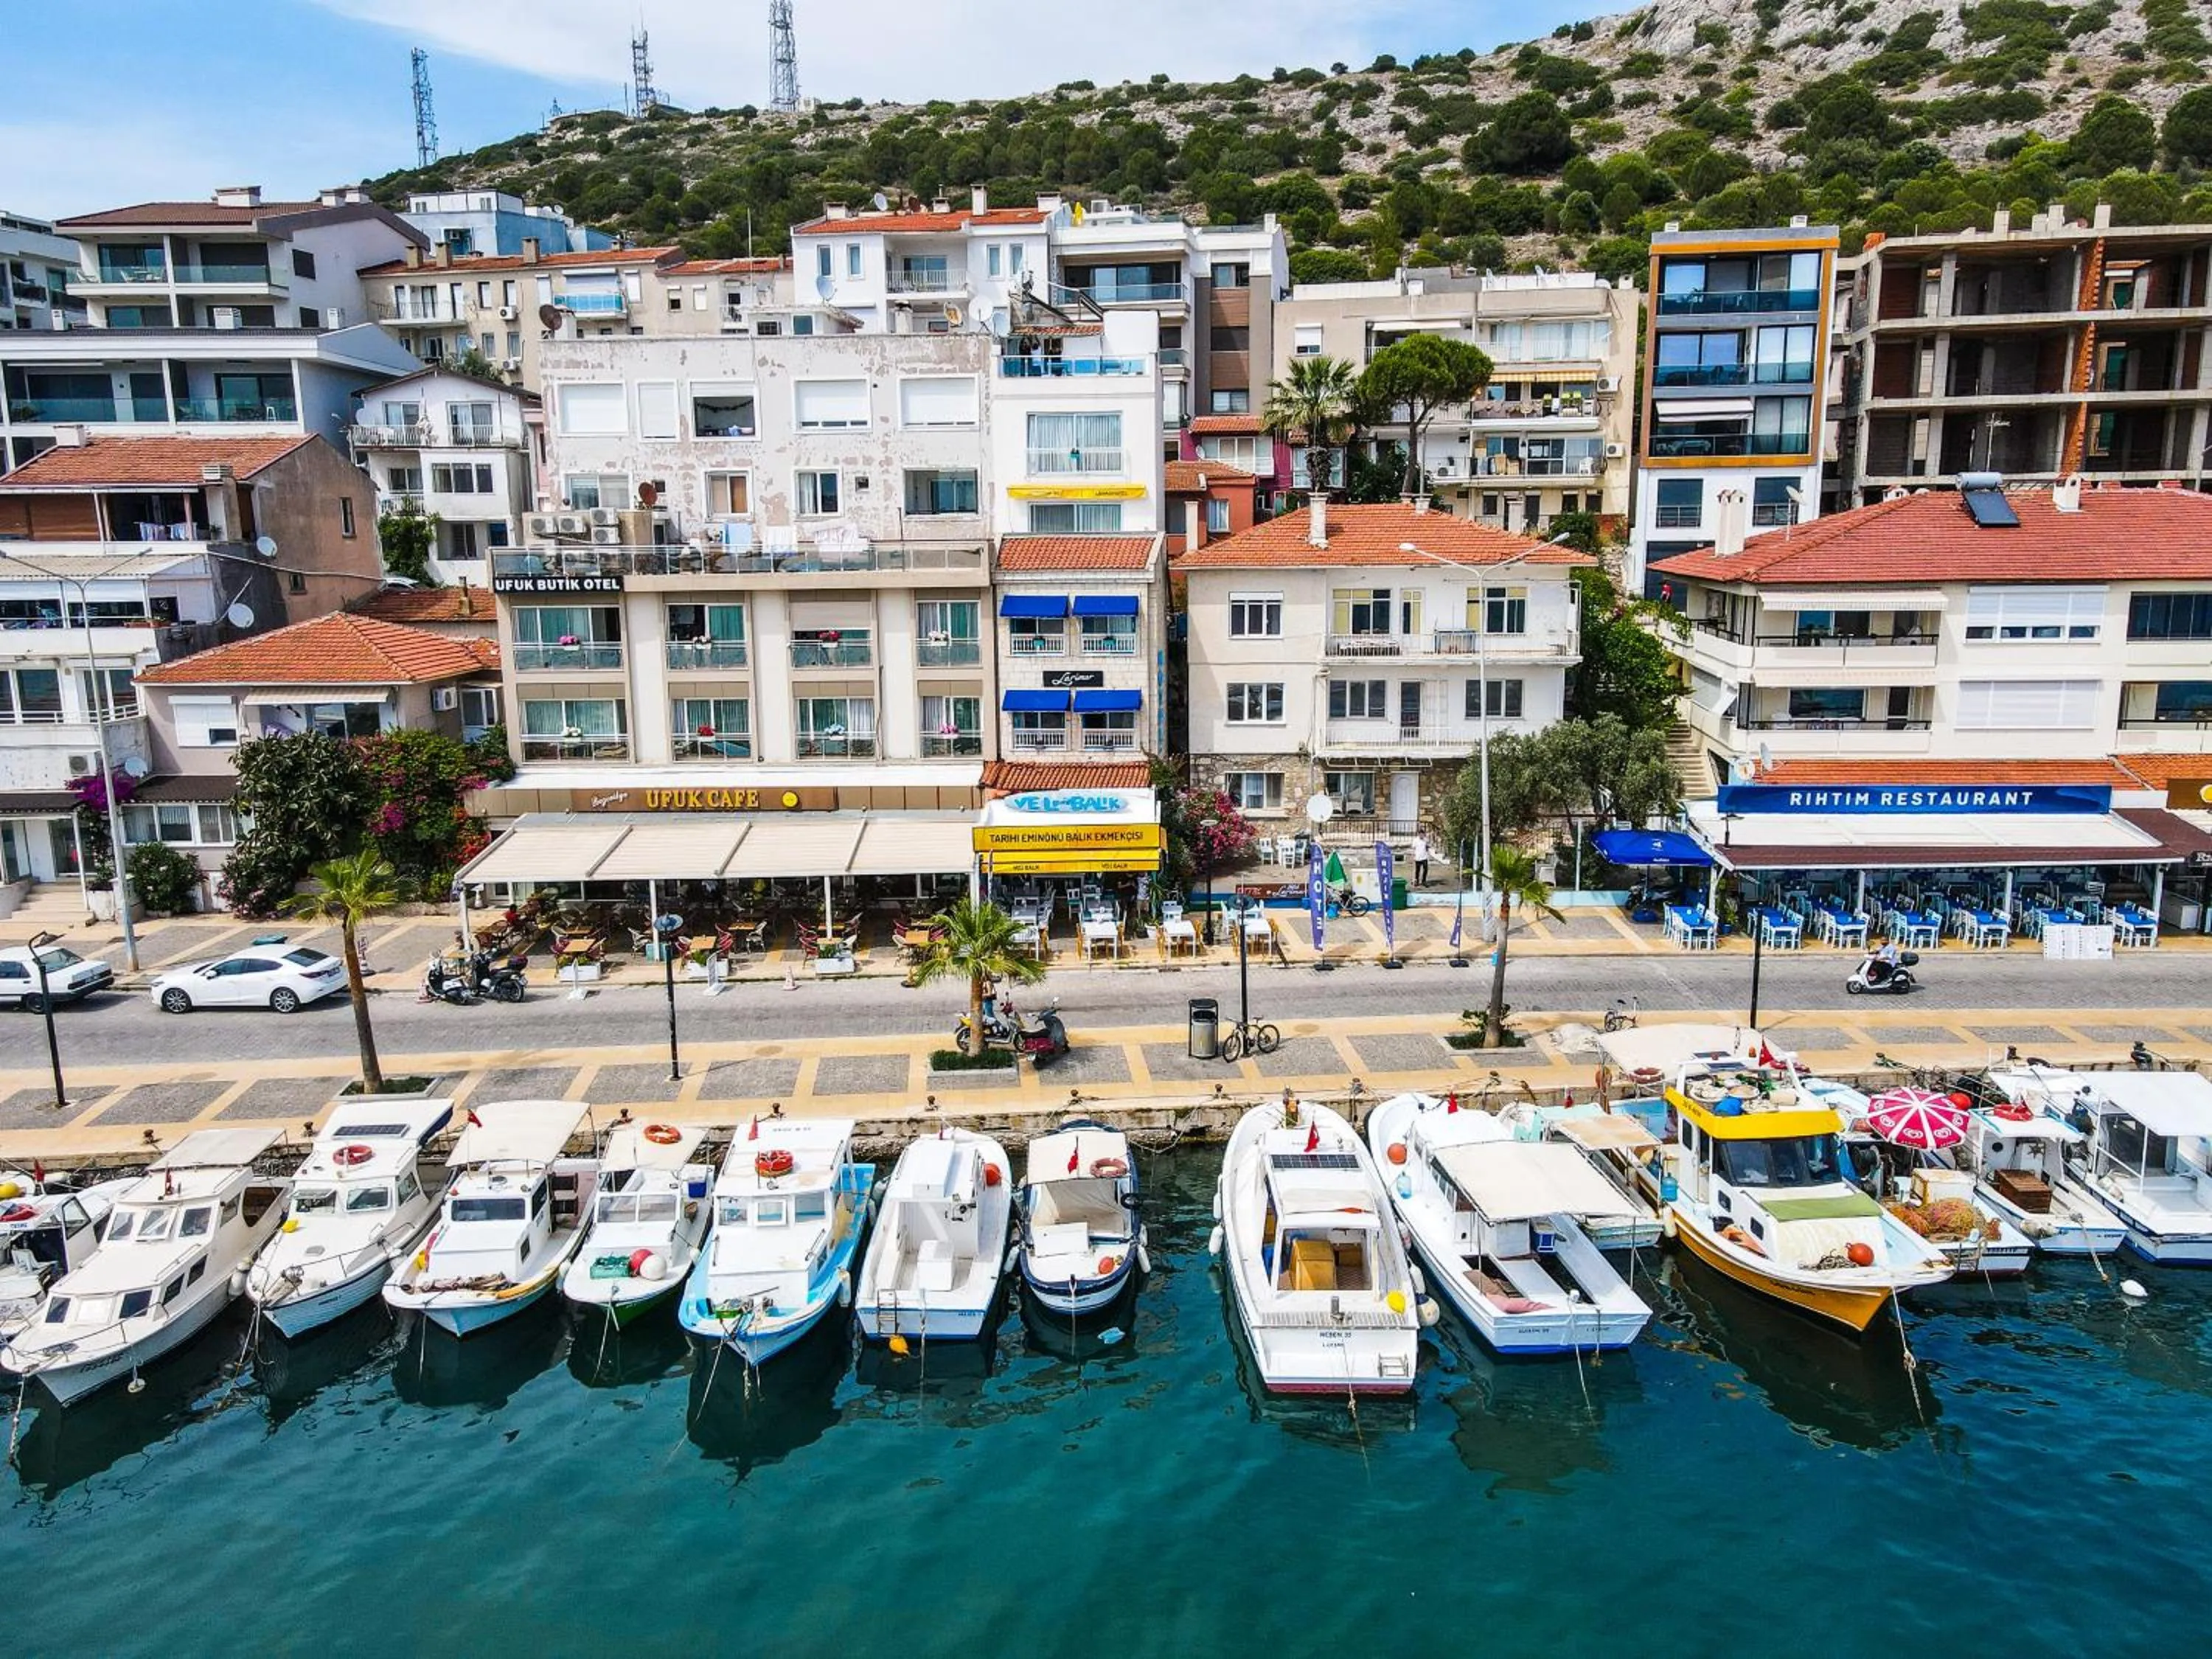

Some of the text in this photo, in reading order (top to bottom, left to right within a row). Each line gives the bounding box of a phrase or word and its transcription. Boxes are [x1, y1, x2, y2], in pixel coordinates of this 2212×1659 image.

[495, 577, 620, 591] UFUK BUTİK OTEL
[645, 790, 703, 808] UFUK
[707, 789, 759, 808] CAFE
[1790, 791, 2034, 806] RIHTIM RESTAURANT
[1065, 832, 1092, 841] BALIK
